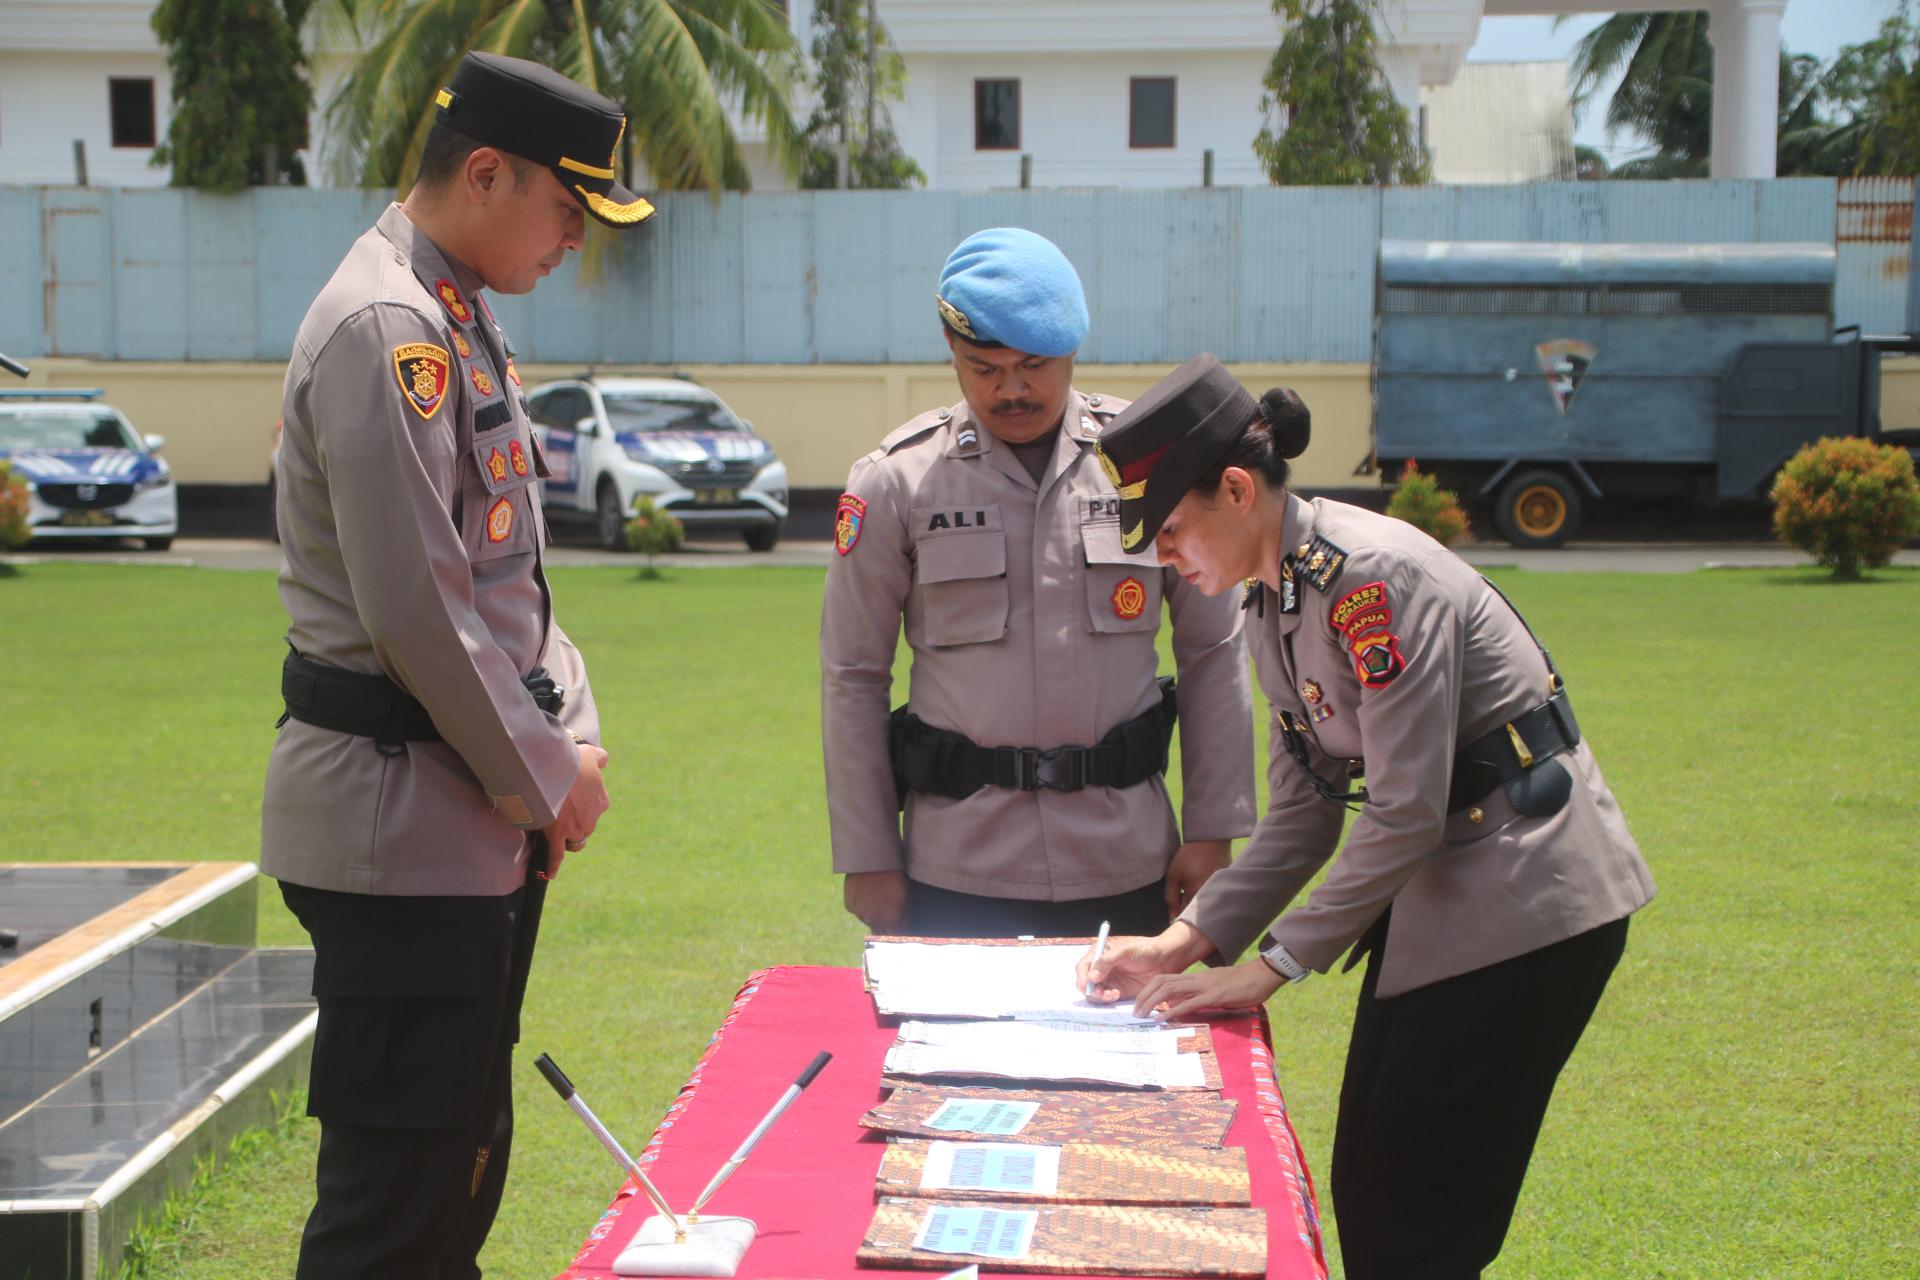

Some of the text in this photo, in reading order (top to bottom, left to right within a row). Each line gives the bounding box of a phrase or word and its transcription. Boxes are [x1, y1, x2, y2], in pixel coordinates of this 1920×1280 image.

[1089, 500, 1120, 519] PO
[928, 511, 986, 531] ALI
[1332, 587, 1380, 622] POLRES
[1348, 614, 1386, 635] PAPUA
